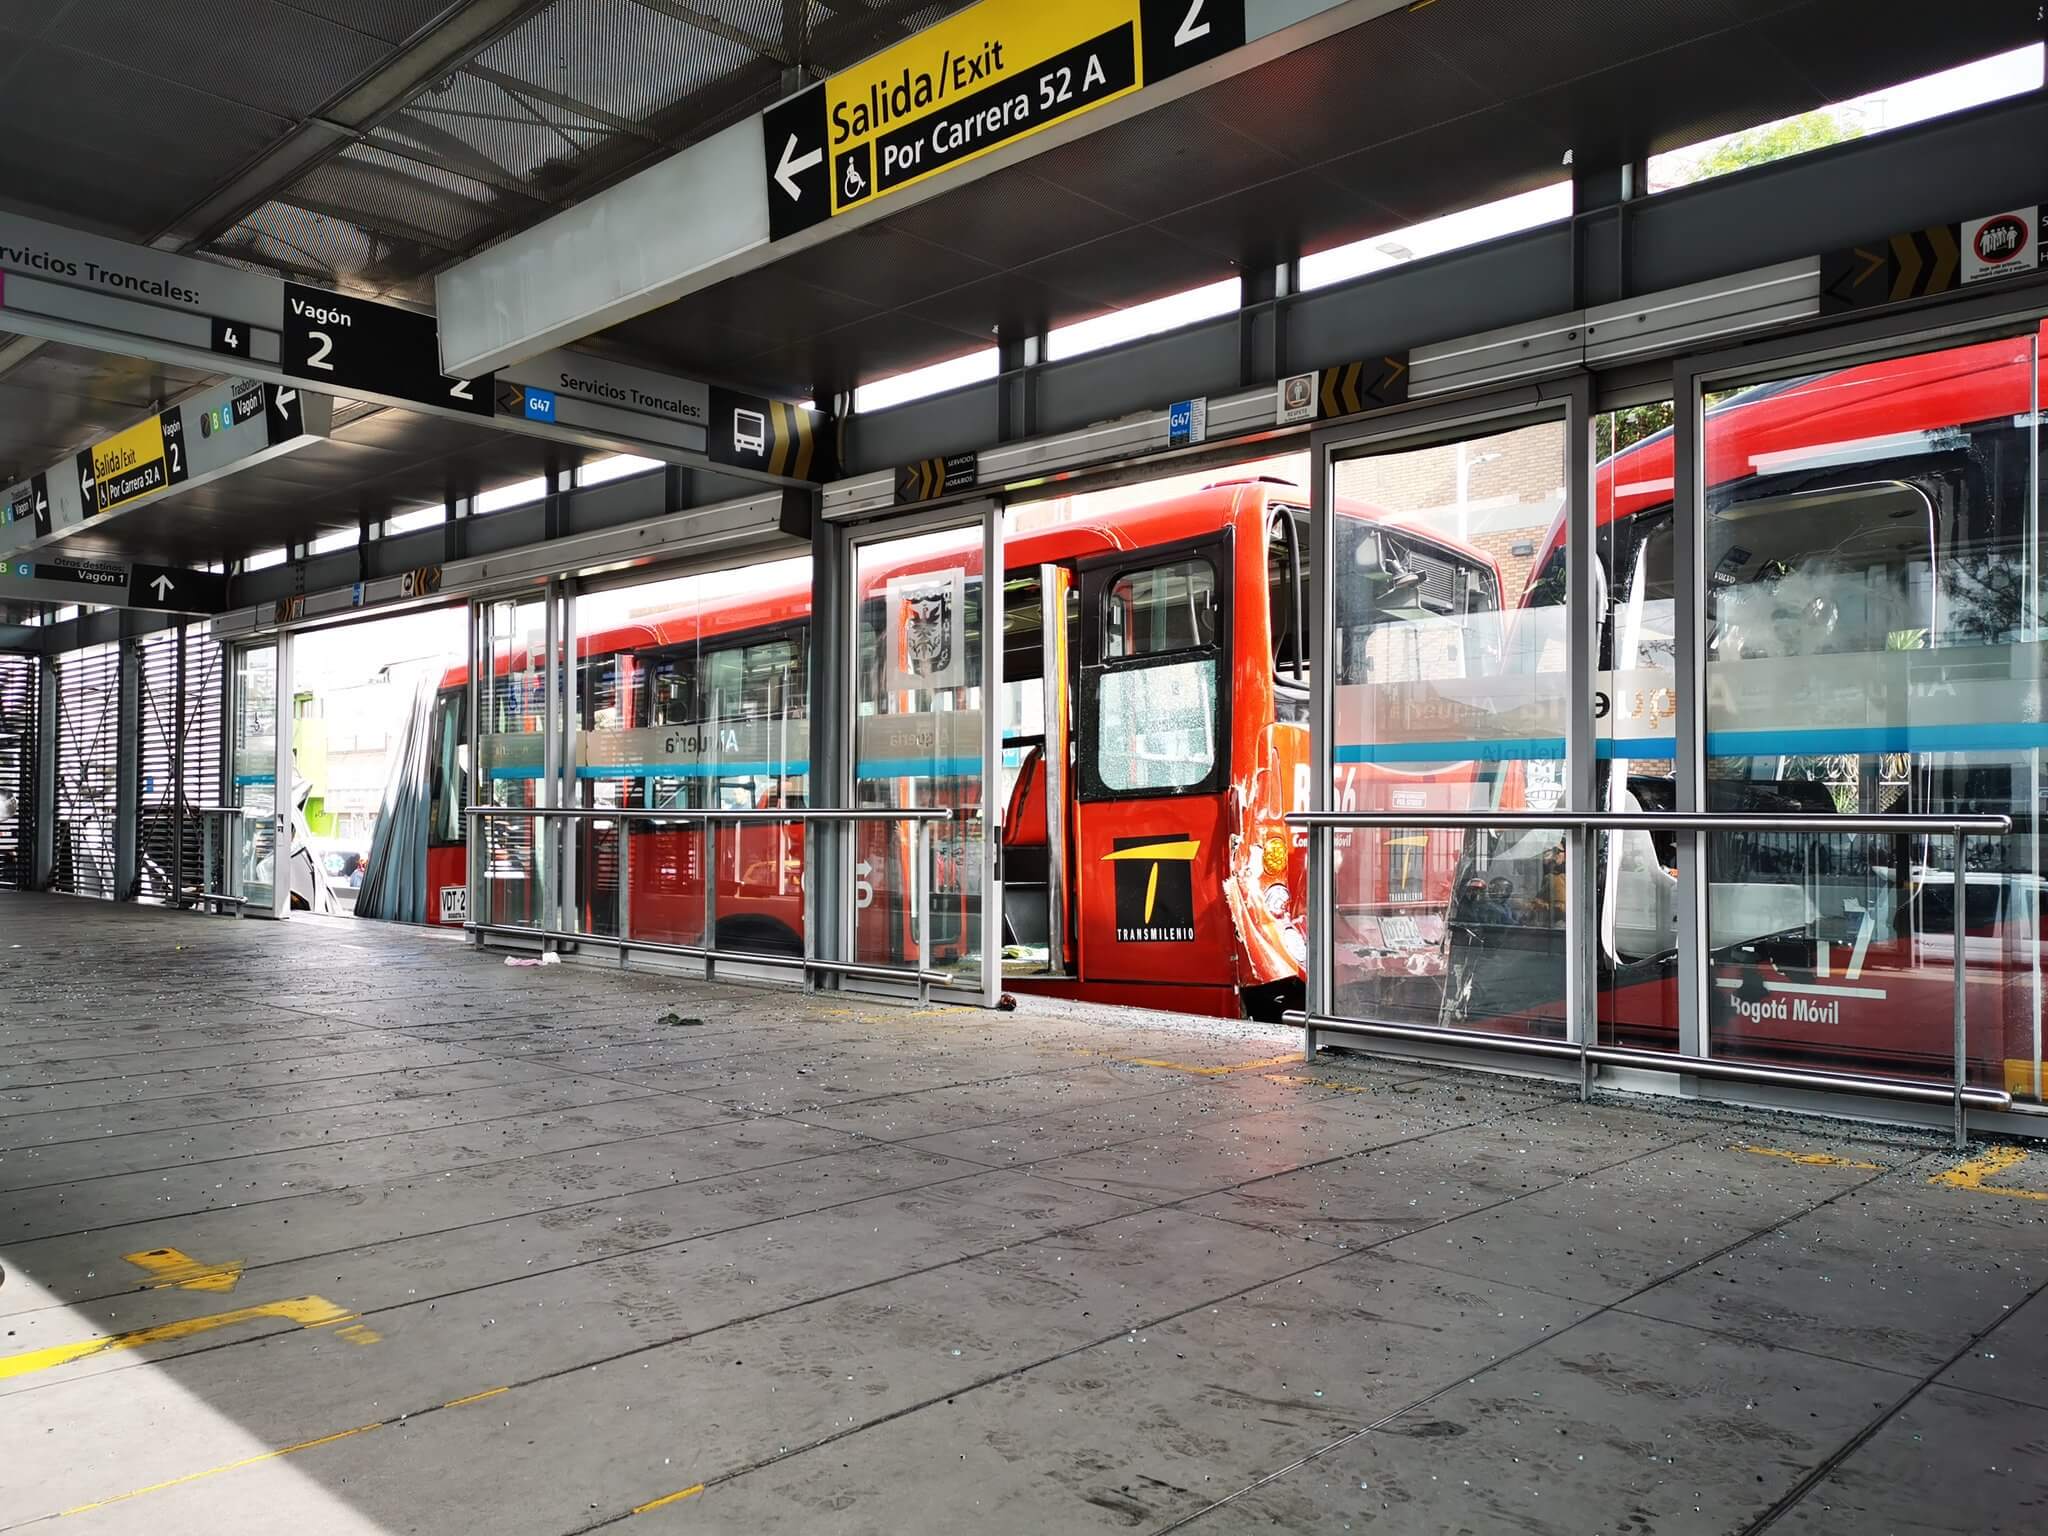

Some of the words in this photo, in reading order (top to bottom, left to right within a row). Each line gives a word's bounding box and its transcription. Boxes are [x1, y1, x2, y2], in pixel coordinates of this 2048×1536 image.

[884, 137, 925, 177] Por
[932, 92, 1030, 154] Carrera
[1039, 66, 1074, 111] 52
[1082, 53, 1107, 92] A
[84, 262, 200, 304] Troncales:
[291, 297, 352, 328] Vagón
[223, 327, 239, 349] 4
[306, 331, 334, 371] 2
[236, 394, 258, 417] Vagón
[529, 397, 551, 413] G47
[559, 372, 626, 401] Servicios
[629, 388, 701, 418] Troncales:
[162, 421, 181, 437] Vagón
[1171, 411, 1190, 428] G47
[170, 443, 181, 473] 2
[109, 484, 121, 500] Por
[120, 476, 145, 495] Carrera
[144, 468, 154, 487] 52
[154, 465, 161, 482] A
[19, 564, 28, 575] G
[77, 569, 115, 584] Vagón
[118, 574, 125, 584] 1
[1116, 927, 1195, 941] TRANSMILENIO
[1792, 998, 1839, 1025] Móvil
